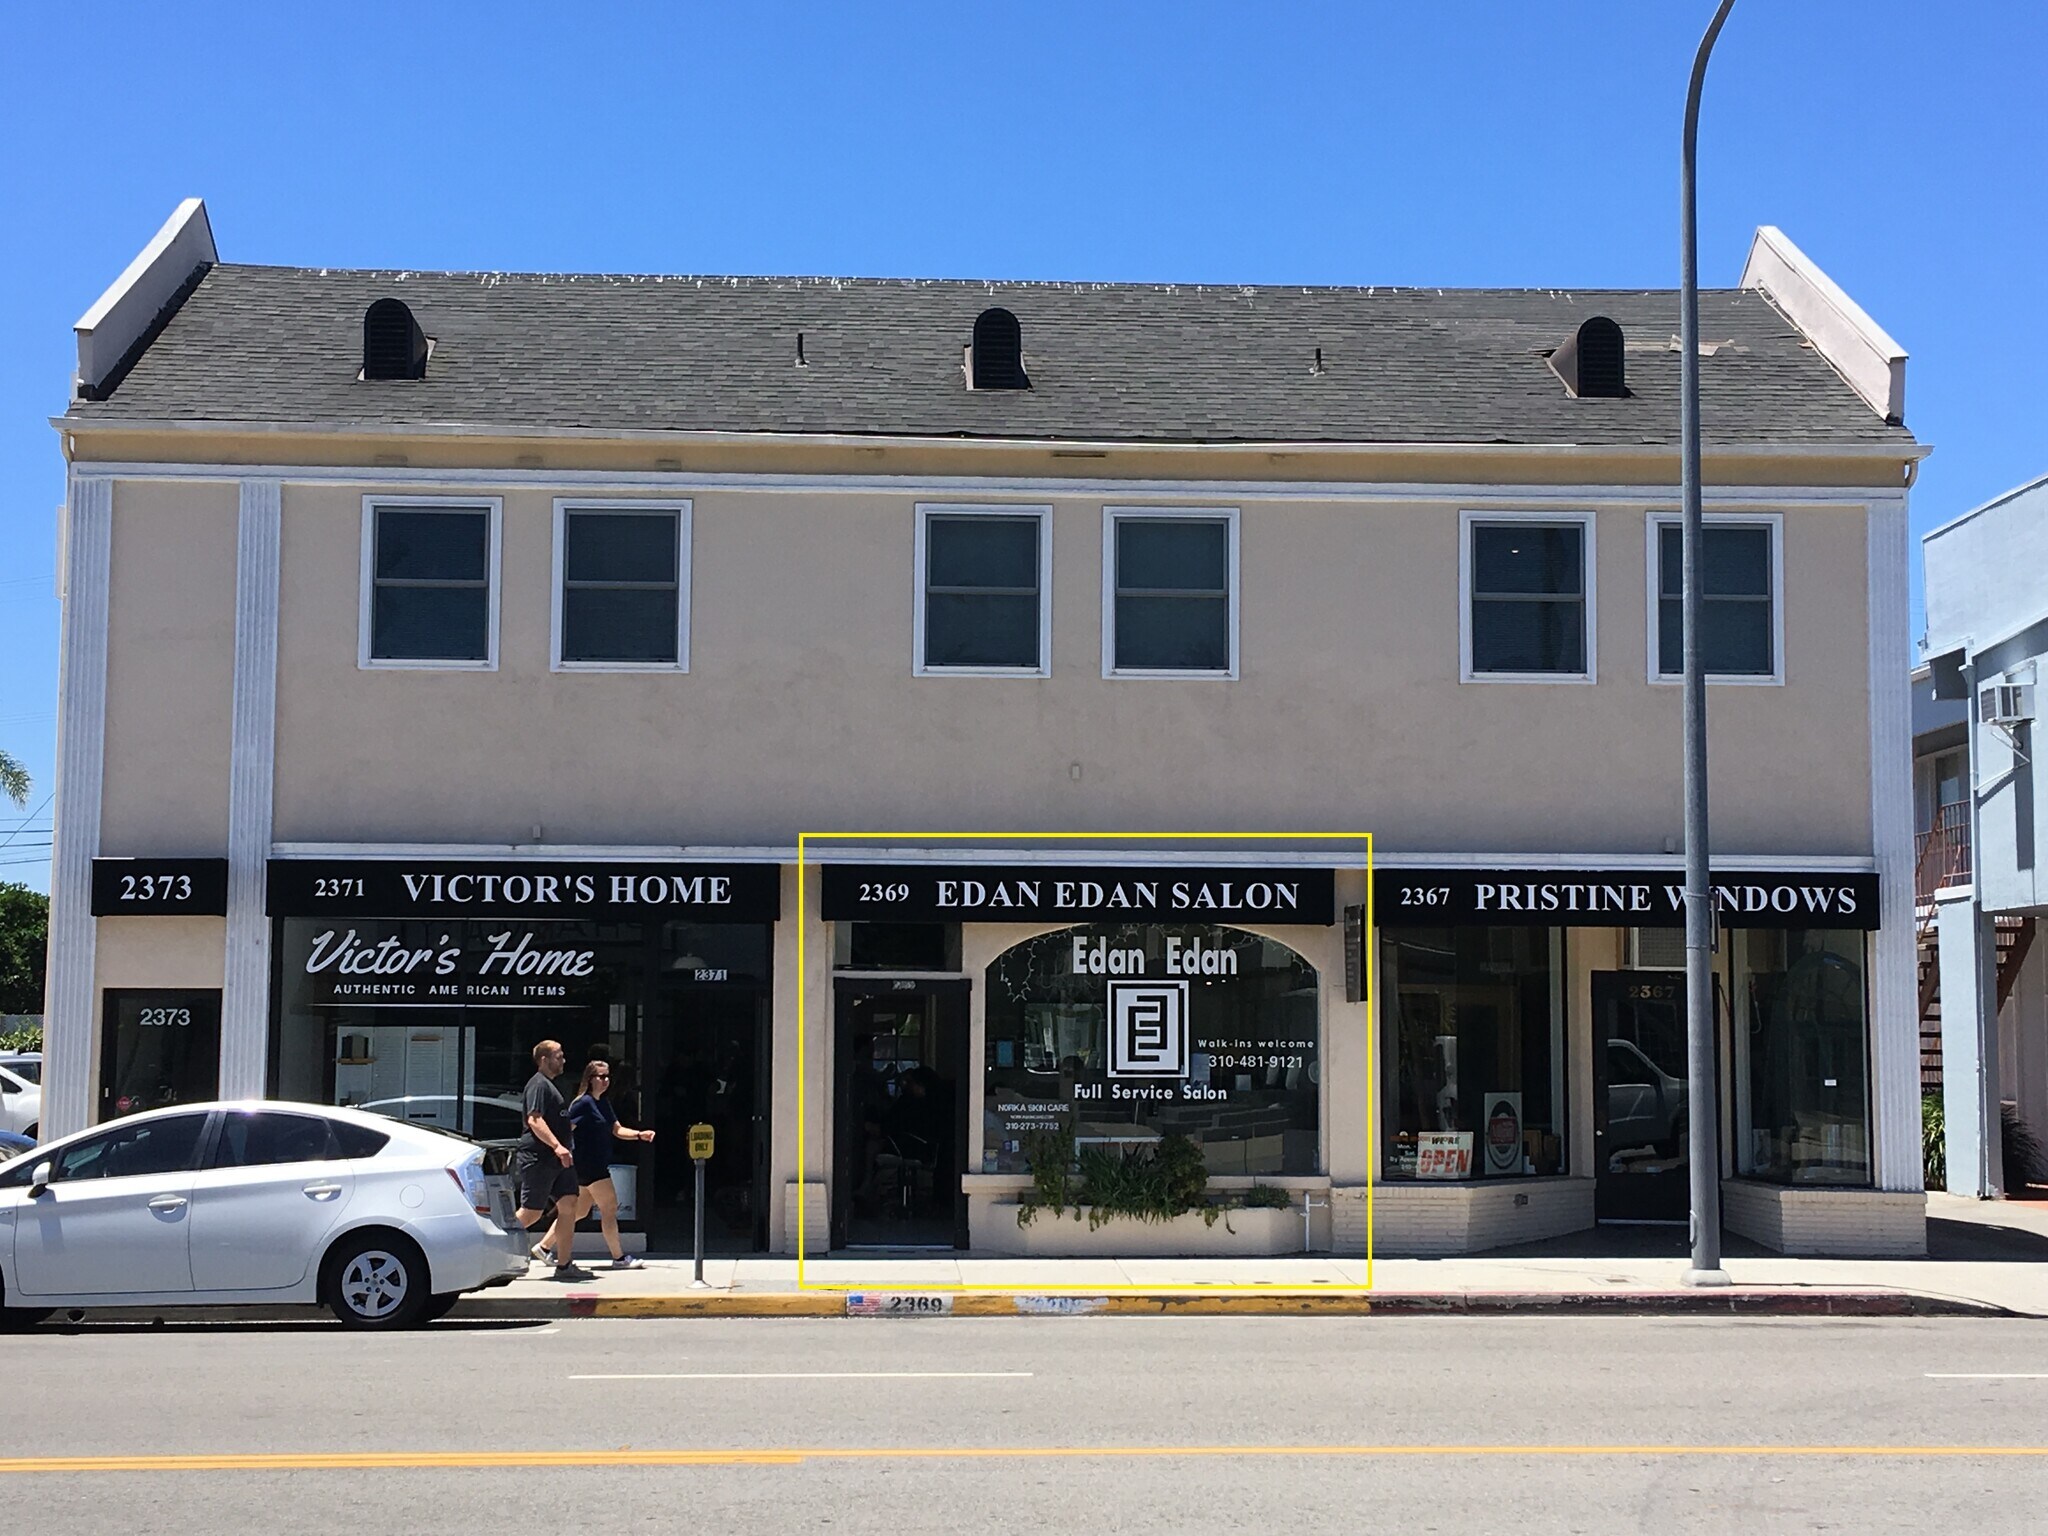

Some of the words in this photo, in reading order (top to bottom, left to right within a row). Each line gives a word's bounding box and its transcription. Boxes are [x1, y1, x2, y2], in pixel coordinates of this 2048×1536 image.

[120, 875, 192, 900] 2373
[314, 878, 365, 897] 2371
[401, 874, 595, 903] VICTOR'S
[608, 875, 732, 904] HOME
[859, 883, 910, 902] 2369
[936, 881, 1040, 908] EDAN
[1053, 881, 1160, 909] EDAN
[1171, 882, 1300, 910] SALON
[1400, 887, 1450, 906] 2367
[1474, 884, 1652, 912] PRISTINE
[1664, 885, 1857, 915] WNDOWS
[305, 929, 461, 975] Victor's
[478, 931, 595, 977] Home
[1072, 936, 1145, 975] Edan
[1166, 936, 1237, 975] Edan
[696, 969, 726, 981] 2371
[333, 984, 416, 995] AUTHENTIC
[523, 985, 566, 996] ITEMS
[1628, 985, 1676, 999] 2367
[139, 1008, 191, 1026] 2373
[1198, 1039, 1252, 1048] Walk-ins
[1257, 1039, 1314, 1048] welcome
[1208, 1054, 1303, 1069] 310-481-9121
[1074, 1083, 1102, 1099] Full
[1111, 1084, 1174, 1100] Service
[1183, 1084, 1228, 1100] Salon
[1047, 1103, 1070, 1112] CARE
[1420, 1149, 1470, 1174] OPEN
[889, 1296, 943, 1313] 2369
